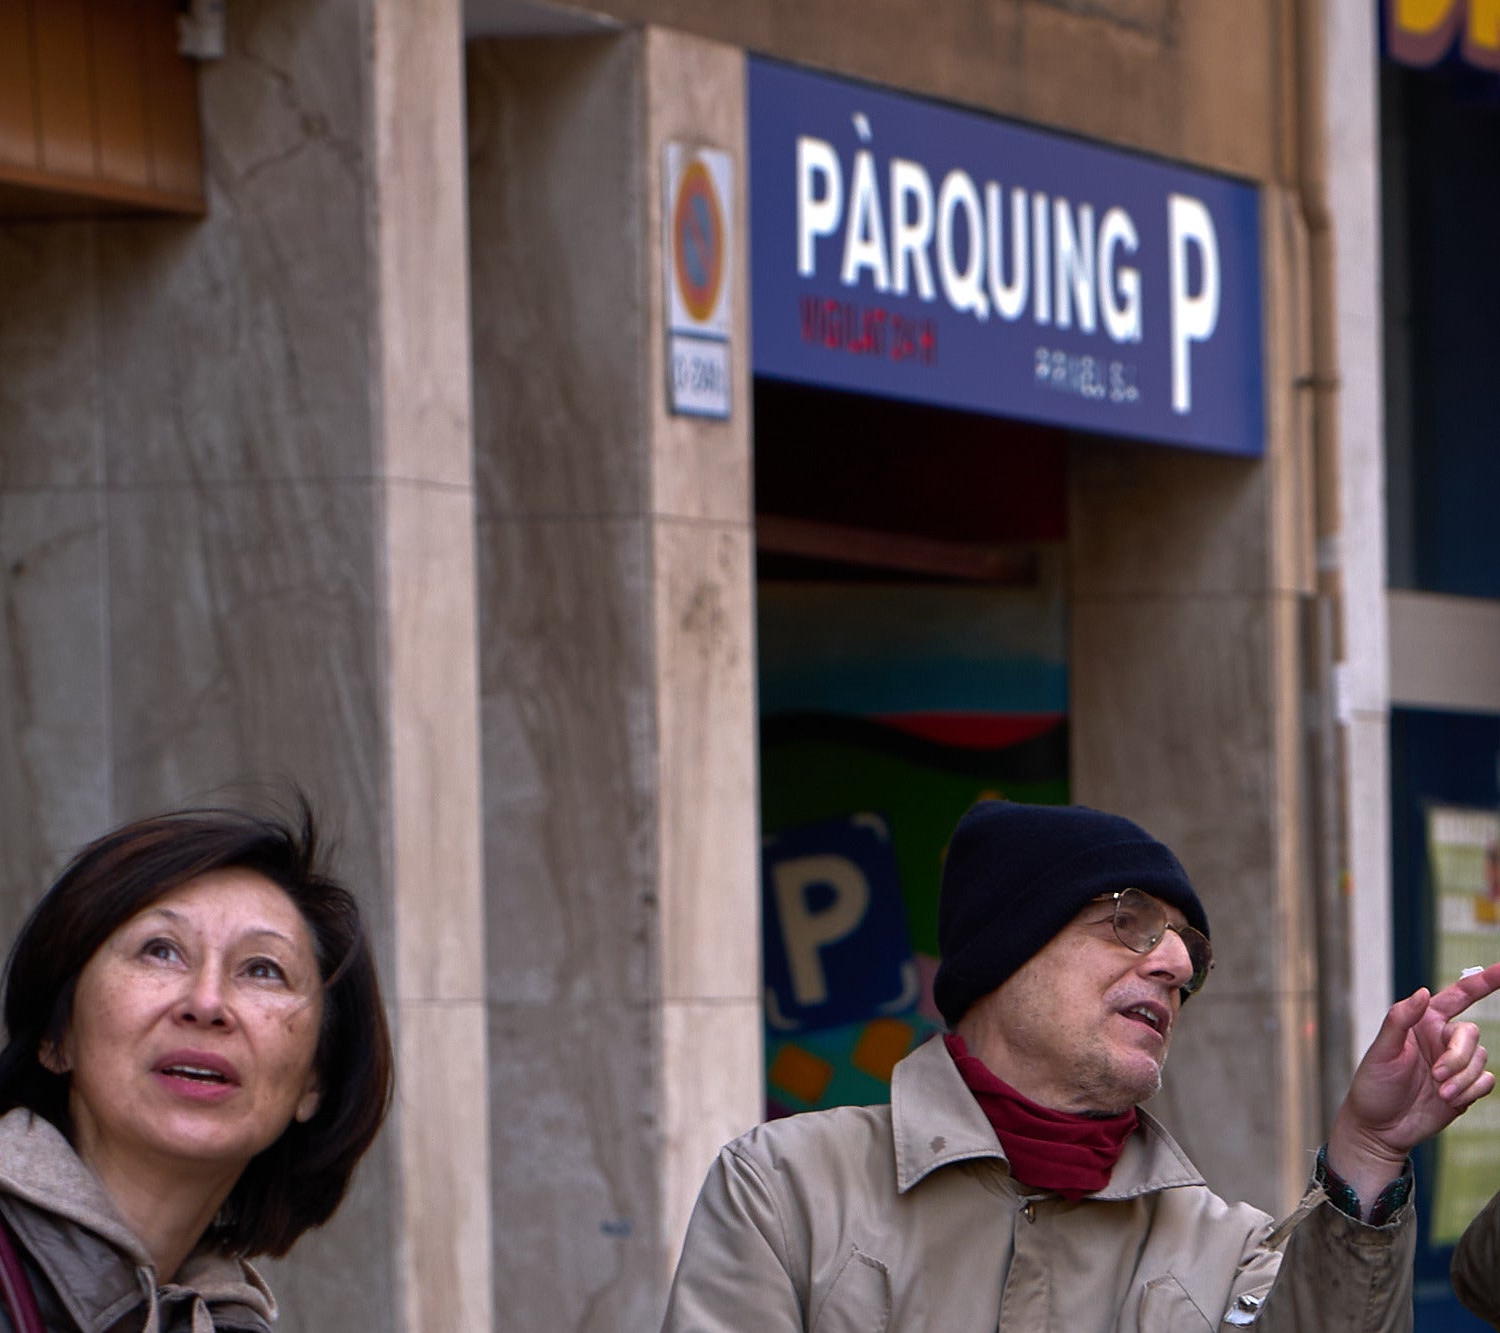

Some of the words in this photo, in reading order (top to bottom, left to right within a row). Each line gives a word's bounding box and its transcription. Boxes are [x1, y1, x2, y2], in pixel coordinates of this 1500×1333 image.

[796, 111, 1143, 344] PÀRQUING
[1168, 192, 1220, 415] P
[771, 854, 871, 1007] P
